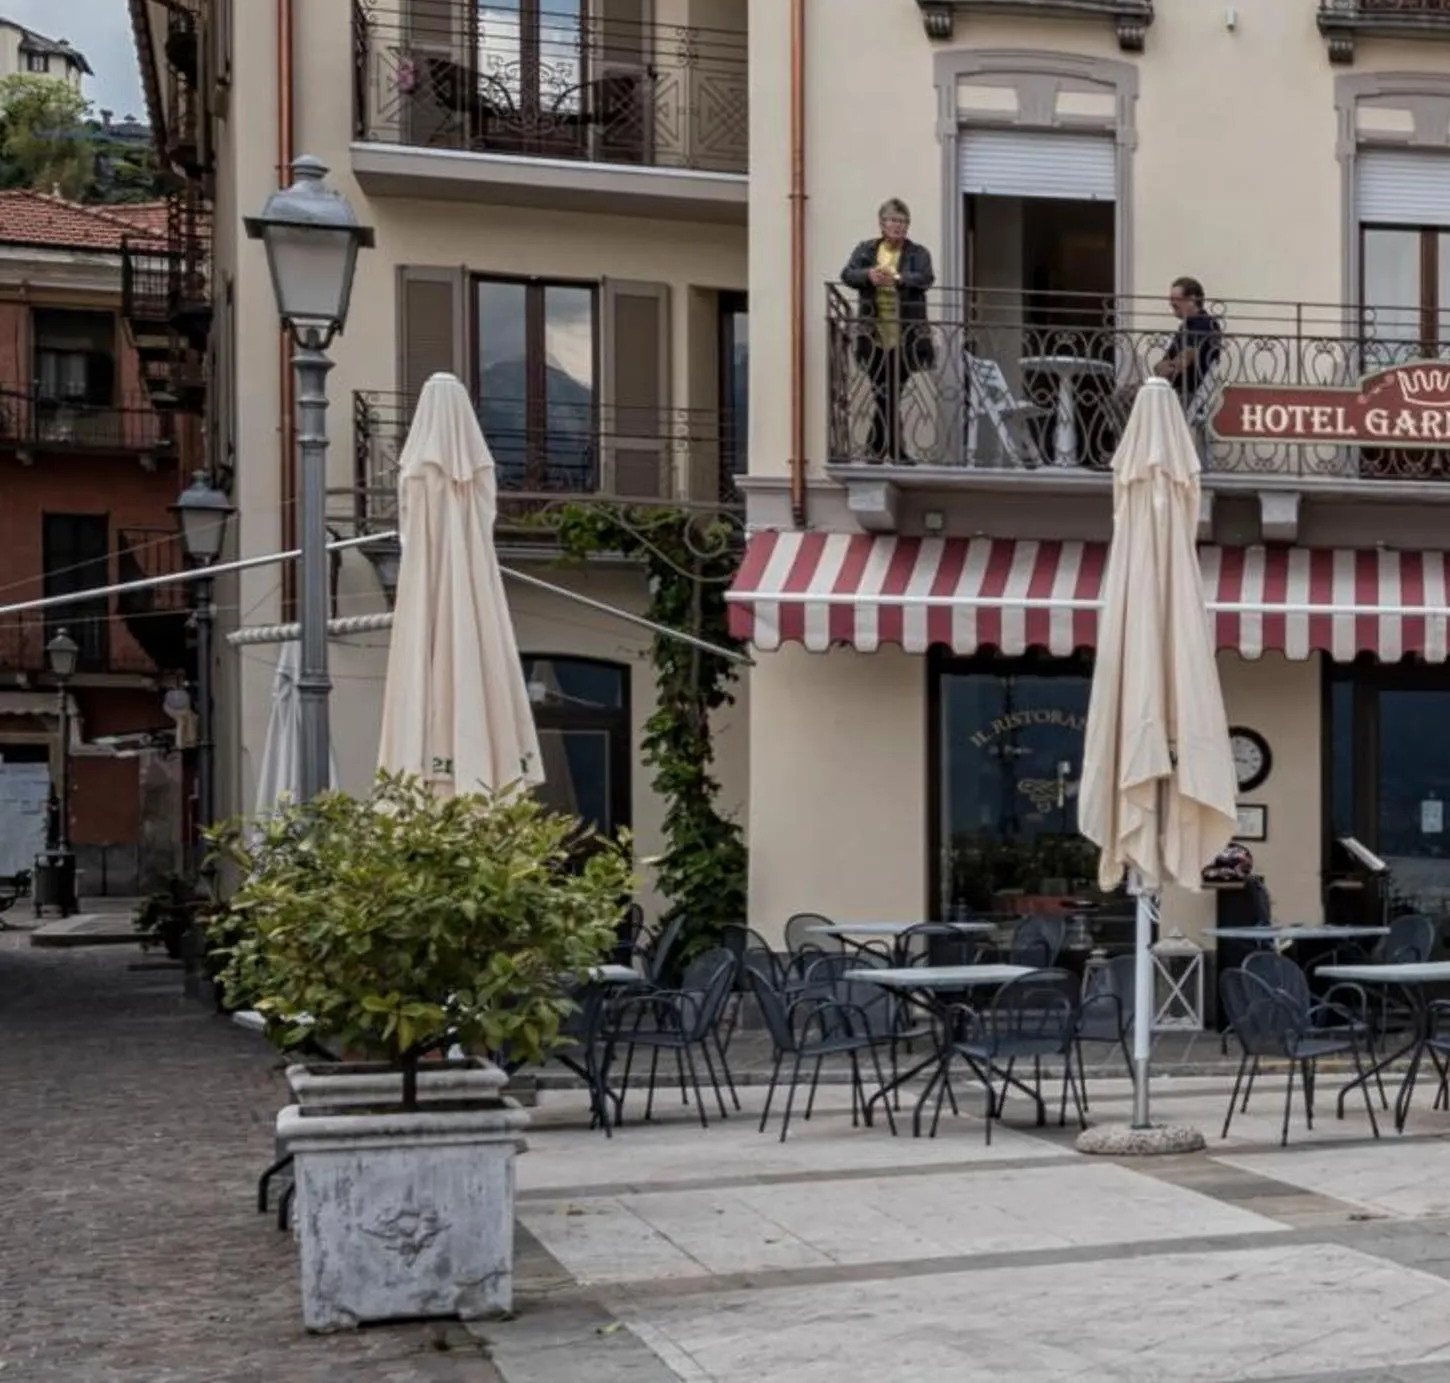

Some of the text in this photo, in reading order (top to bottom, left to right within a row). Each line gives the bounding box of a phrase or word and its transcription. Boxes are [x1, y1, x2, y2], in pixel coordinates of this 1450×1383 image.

[1240, 403, 1357, 435] HOTEL
[969, 709, 1087, 747] IL RISTORAN
